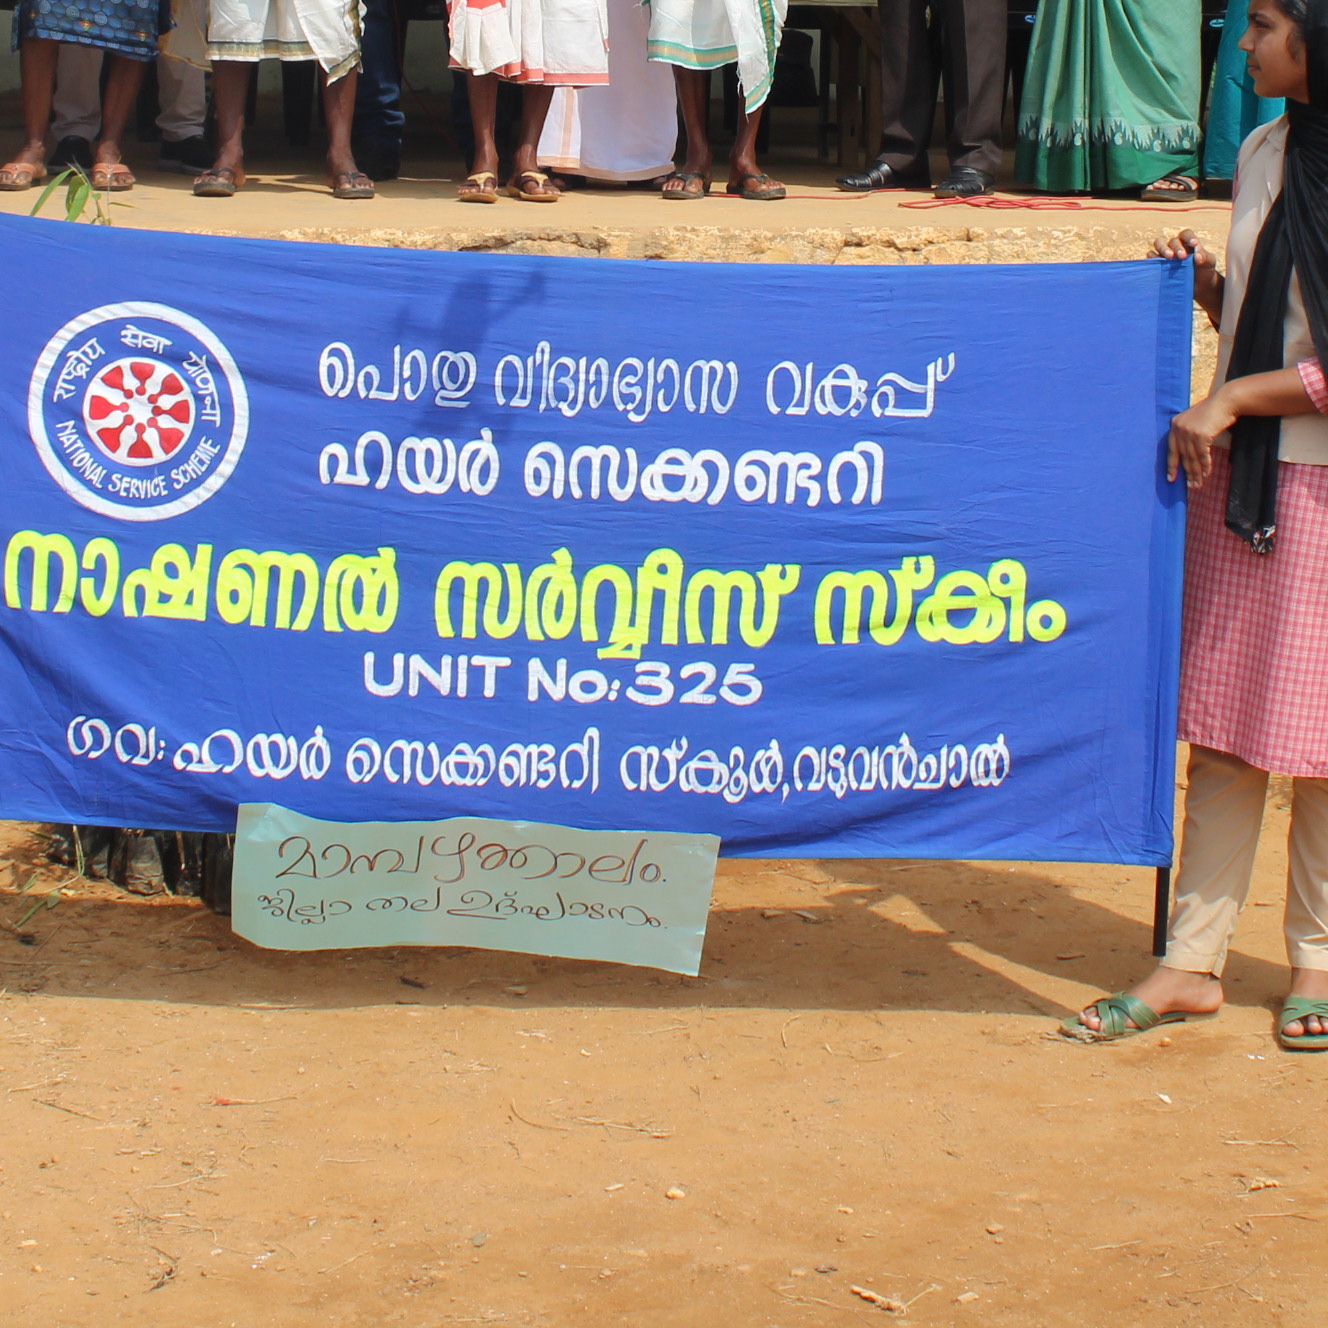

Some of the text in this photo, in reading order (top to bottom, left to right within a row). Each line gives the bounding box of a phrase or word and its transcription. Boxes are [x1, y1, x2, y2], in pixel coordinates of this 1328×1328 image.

[120, 324, 173, 354] सेवा
[318, 340, 956, 424] പൊതു വിദ്യാഭ്യാസ വകുപ്പ്
[56, 419, 221, 500] NATIONAL SERVICE SCHEME
[318, 427, 885, 508] ഹയർ സെക്കണ്ടറി
[4, 529, 1068, 660] നാഷണൽ സർവ്വീസ് സ്കീം
[363, 651, 512, 699] UNIT
[172, 725, 331, 781] ഹയർ
[345, 726, 600, 794] സെക്കണ്ടറി
